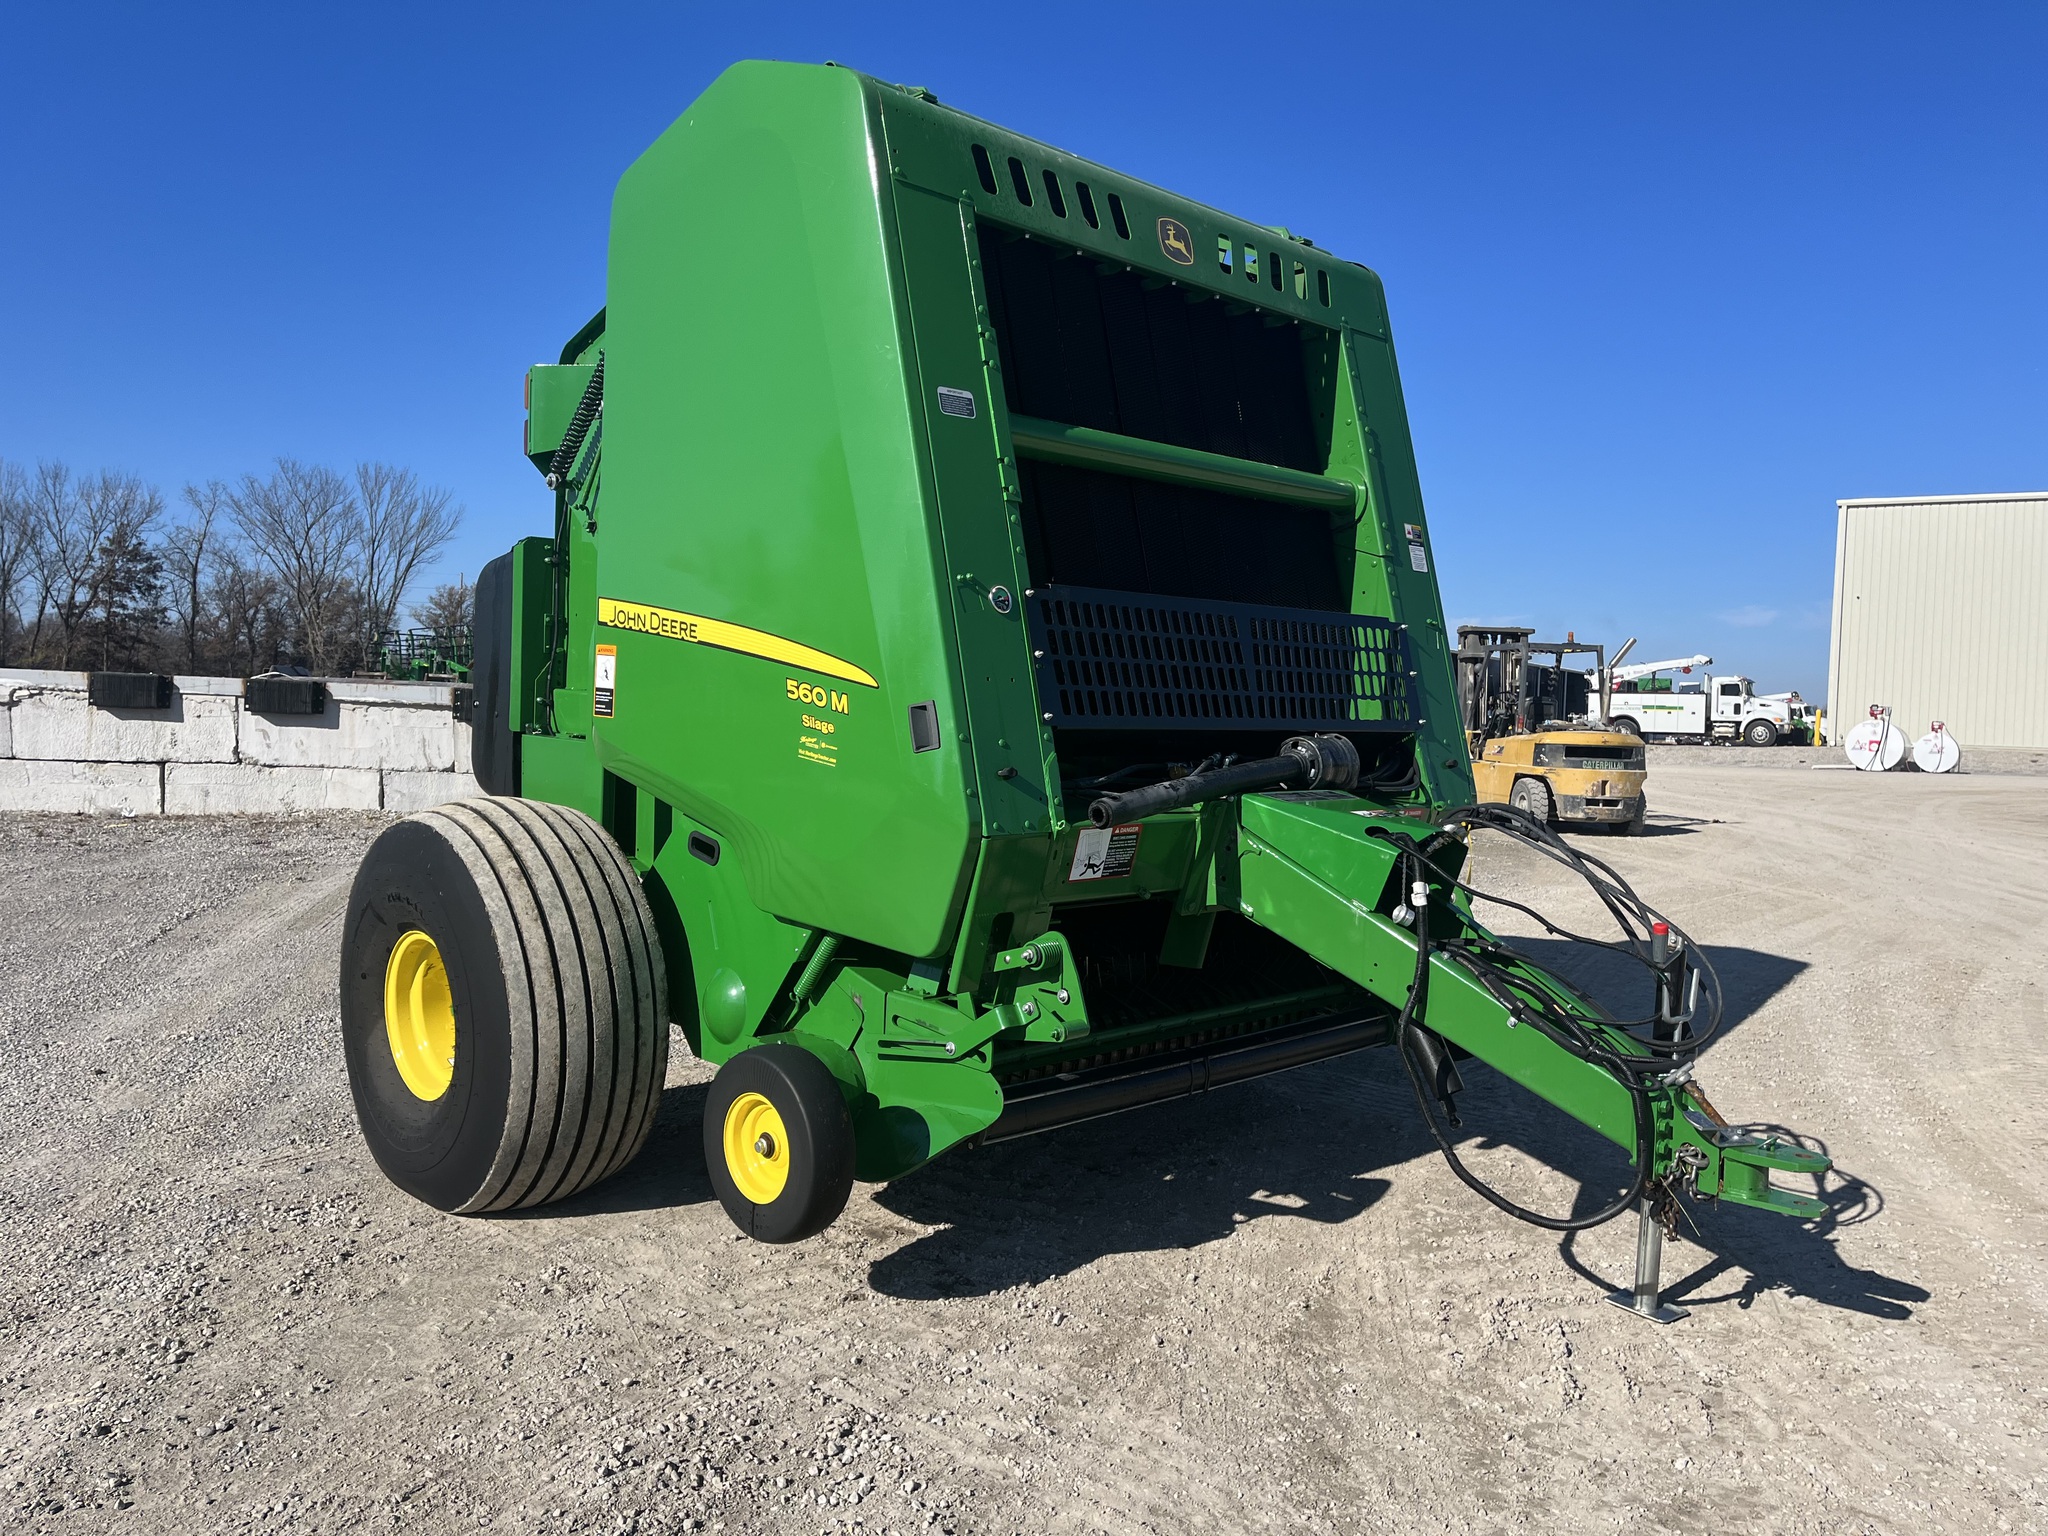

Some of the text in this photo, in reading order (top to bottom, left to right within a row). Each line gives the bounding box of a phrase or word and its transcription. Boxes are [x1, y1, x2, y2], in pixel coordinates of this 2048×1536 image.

[609, 605, 698, 639] JOHN DEERE
[786, 677, 849, 716] 560 M
[801, 713, 835, 735] Silage
[1582, 760, 1625, 770] CATERPILLAR
